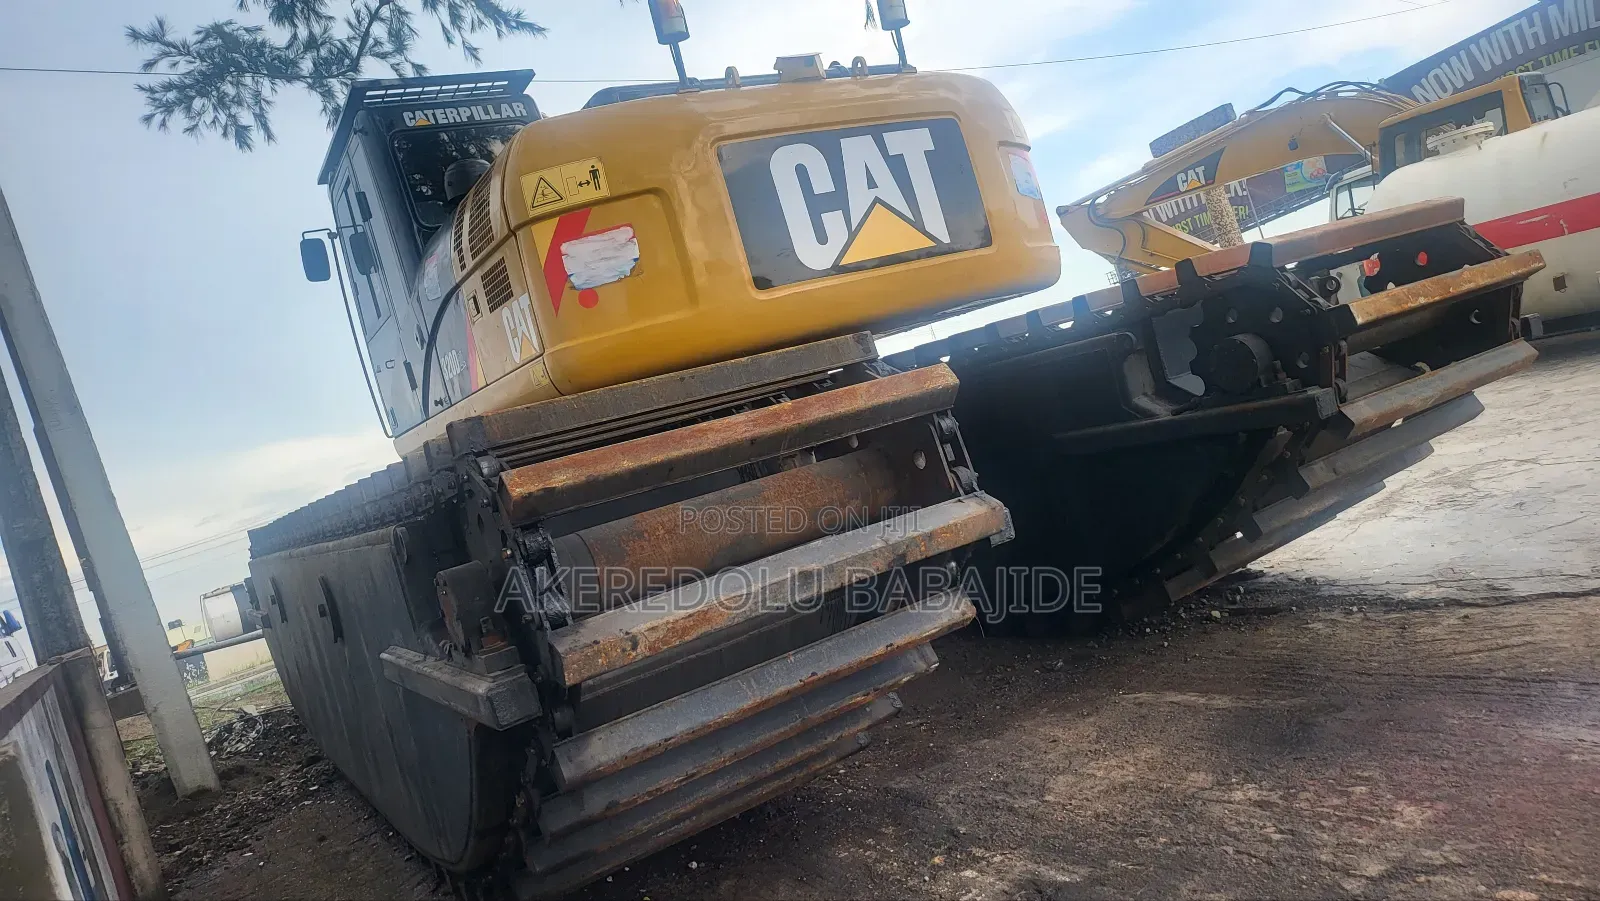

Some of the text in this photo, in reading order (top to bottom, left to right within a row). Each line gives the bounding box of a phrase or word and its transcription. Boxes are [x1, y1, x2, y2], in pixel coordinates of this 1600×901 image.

[1411, 50, 1475, 104] NOW
[1469, 11, 1547, 72] WITH
[402, 102, 528, 127] CATERPILLAR
[769, 127, 951, 271] CAT
[1176, 165, 1206, 192] CAT
[502, 293, 540, 364] CAT
